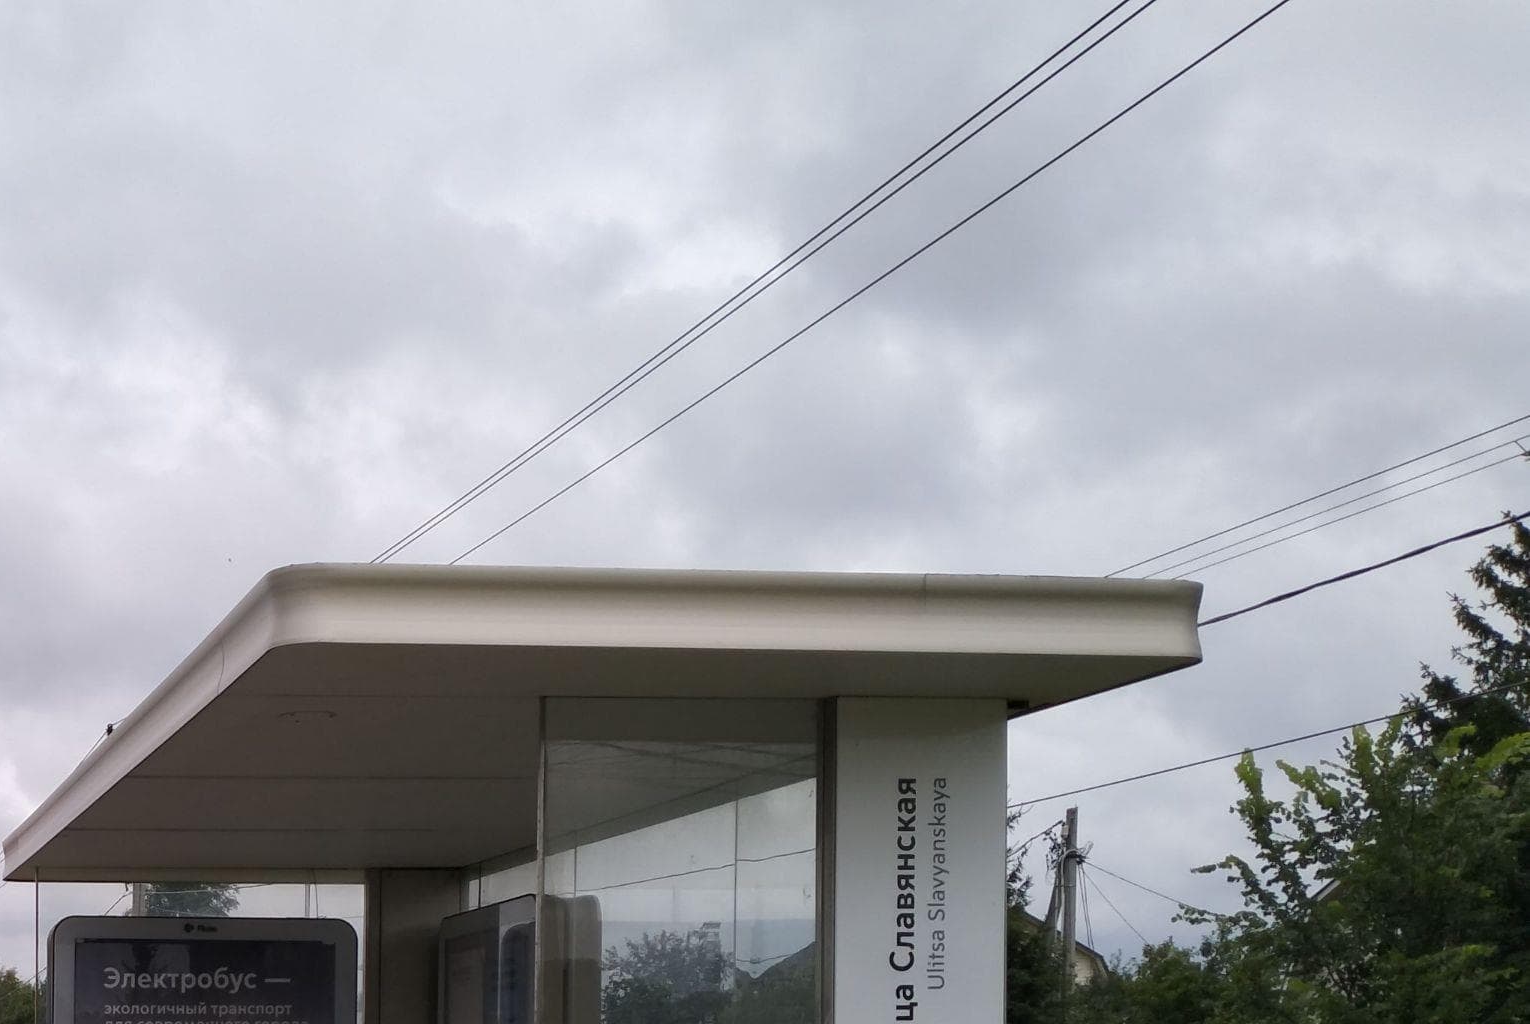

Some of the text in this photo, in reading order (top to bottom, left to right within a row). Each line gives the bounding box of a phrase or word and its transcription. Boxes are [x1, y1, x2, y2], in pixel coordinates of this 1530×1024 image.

[888, 777, 917, 972] Славянская
[927, 776, 951, 990] Ulitsa Slavyanskaya
[103, 966, 257, 994] Электробус
[103, 1002, 293, 1018] экологичный транспорт
